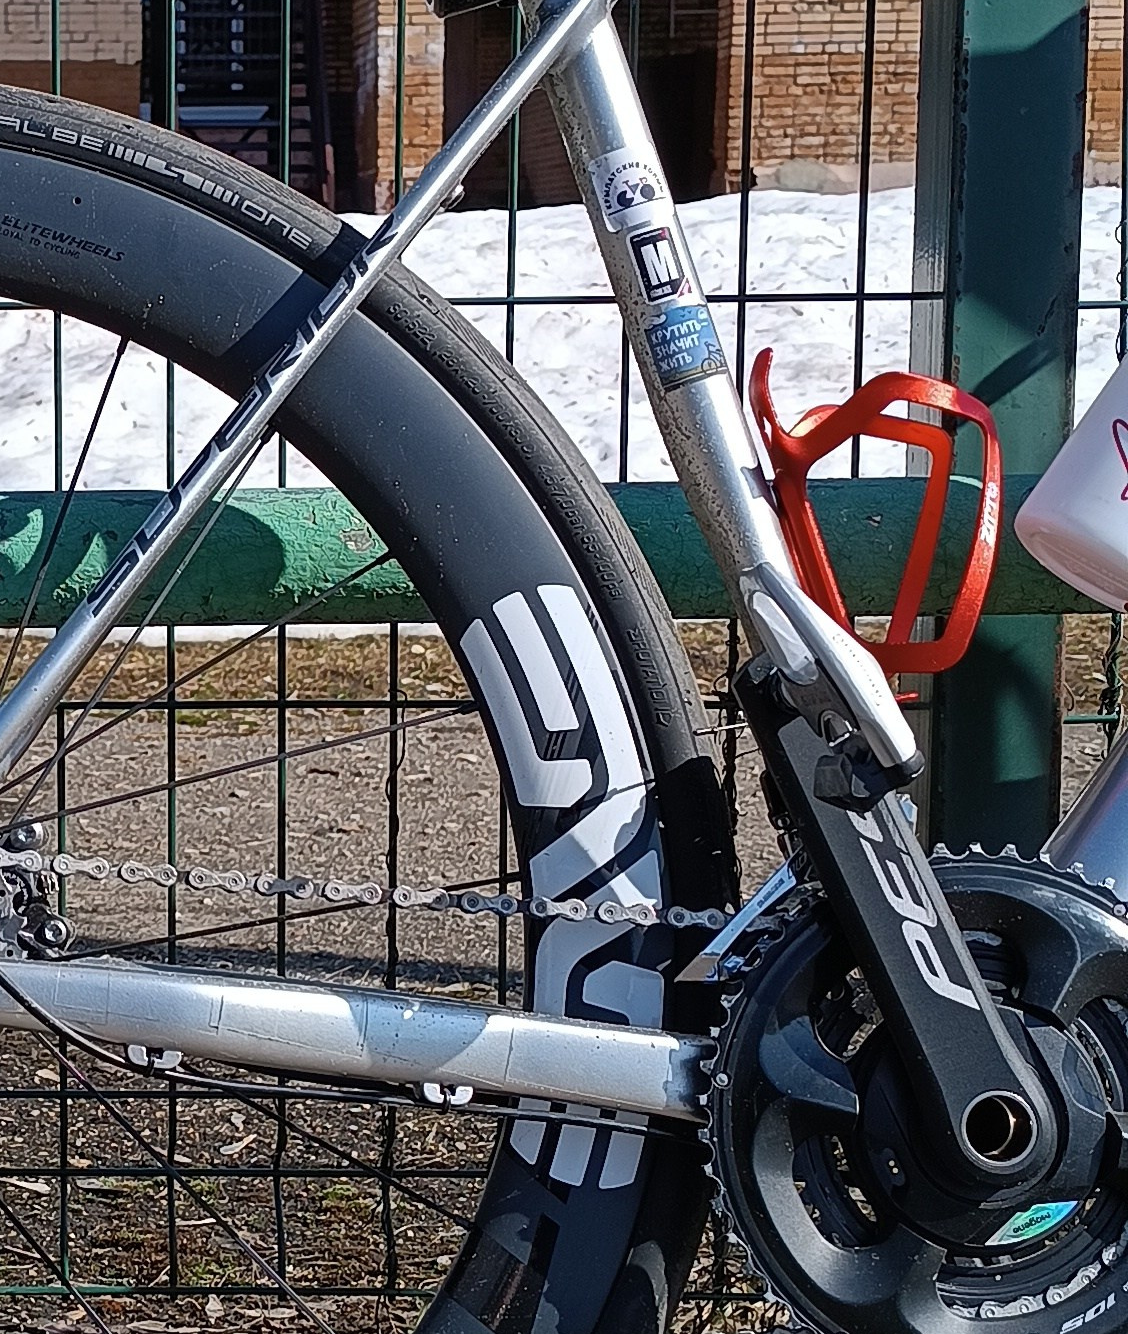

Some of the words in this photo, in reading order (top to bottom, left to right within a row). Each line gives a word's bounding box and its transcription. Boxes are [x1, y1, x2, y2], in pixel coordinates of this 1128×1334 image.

[1, 214, 125, 262] ELITEWHEELS
[241, 199, 314, 249] ONE
[29, 237, 41, 247] TO
[44, 241, 81, 260] CYCLING
[654, 332, 701, 360] ЗНАЧИТ
[659, 354, 693, 372] ЖИТЬ
[1059, 1292, 1116, 1334] 105
